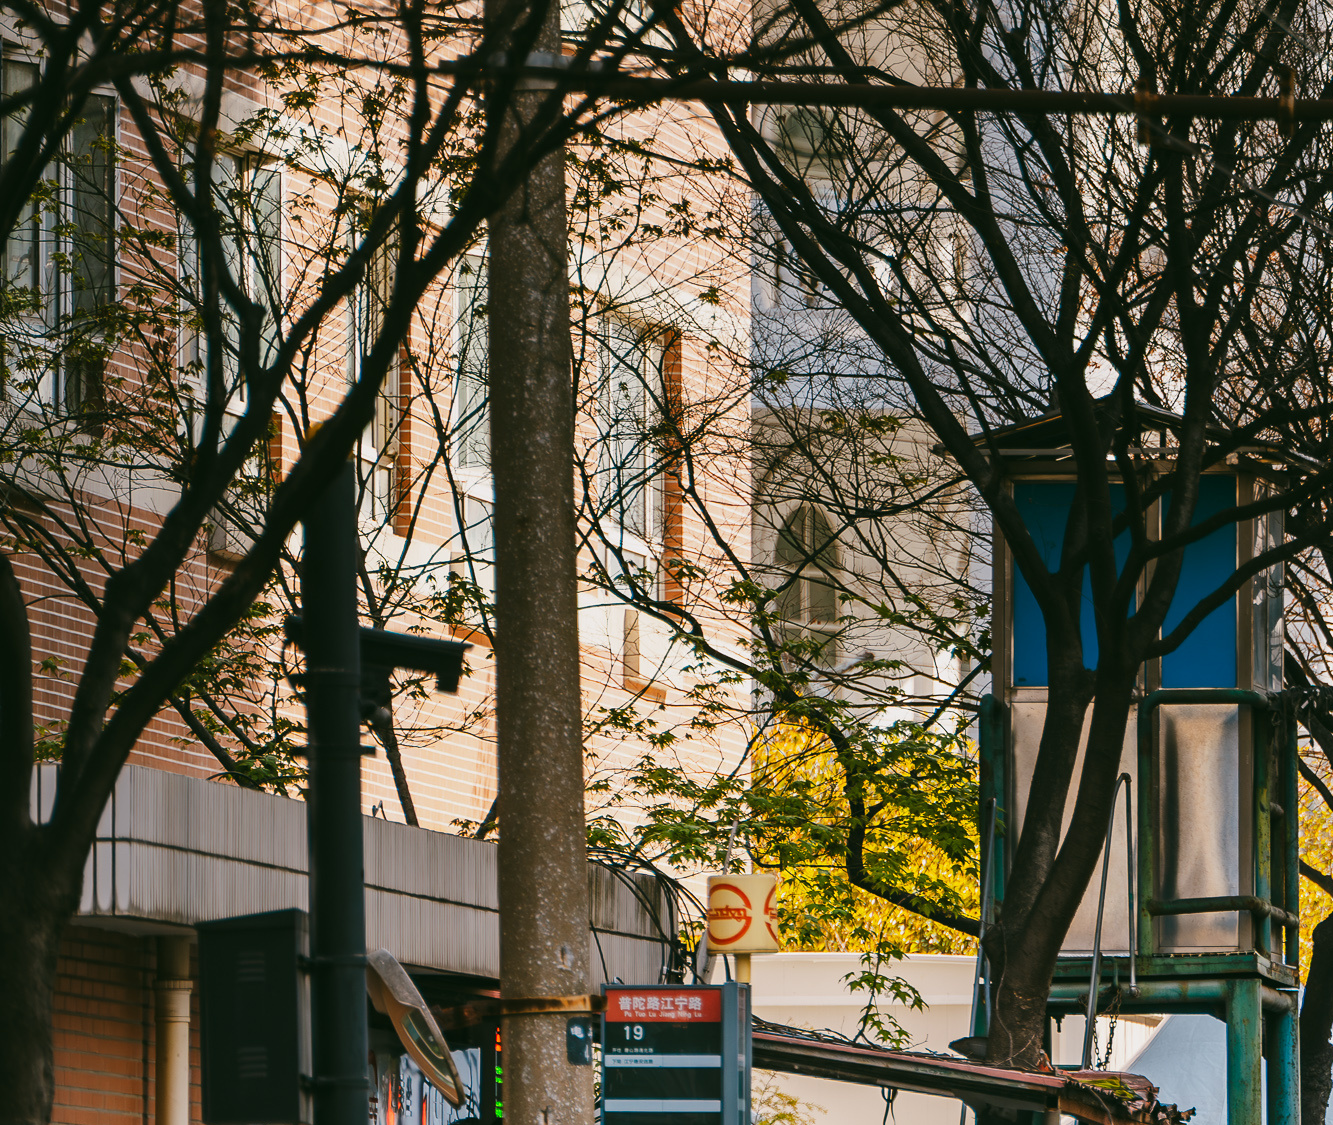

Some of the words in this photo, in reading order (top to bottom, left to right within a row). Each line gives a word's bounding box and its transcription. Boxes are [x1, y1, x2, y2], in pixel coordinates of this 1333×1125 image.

[618, 996, 702, 1011] 普陀路江宁路
[623, 1025, 643, 1040] 19
